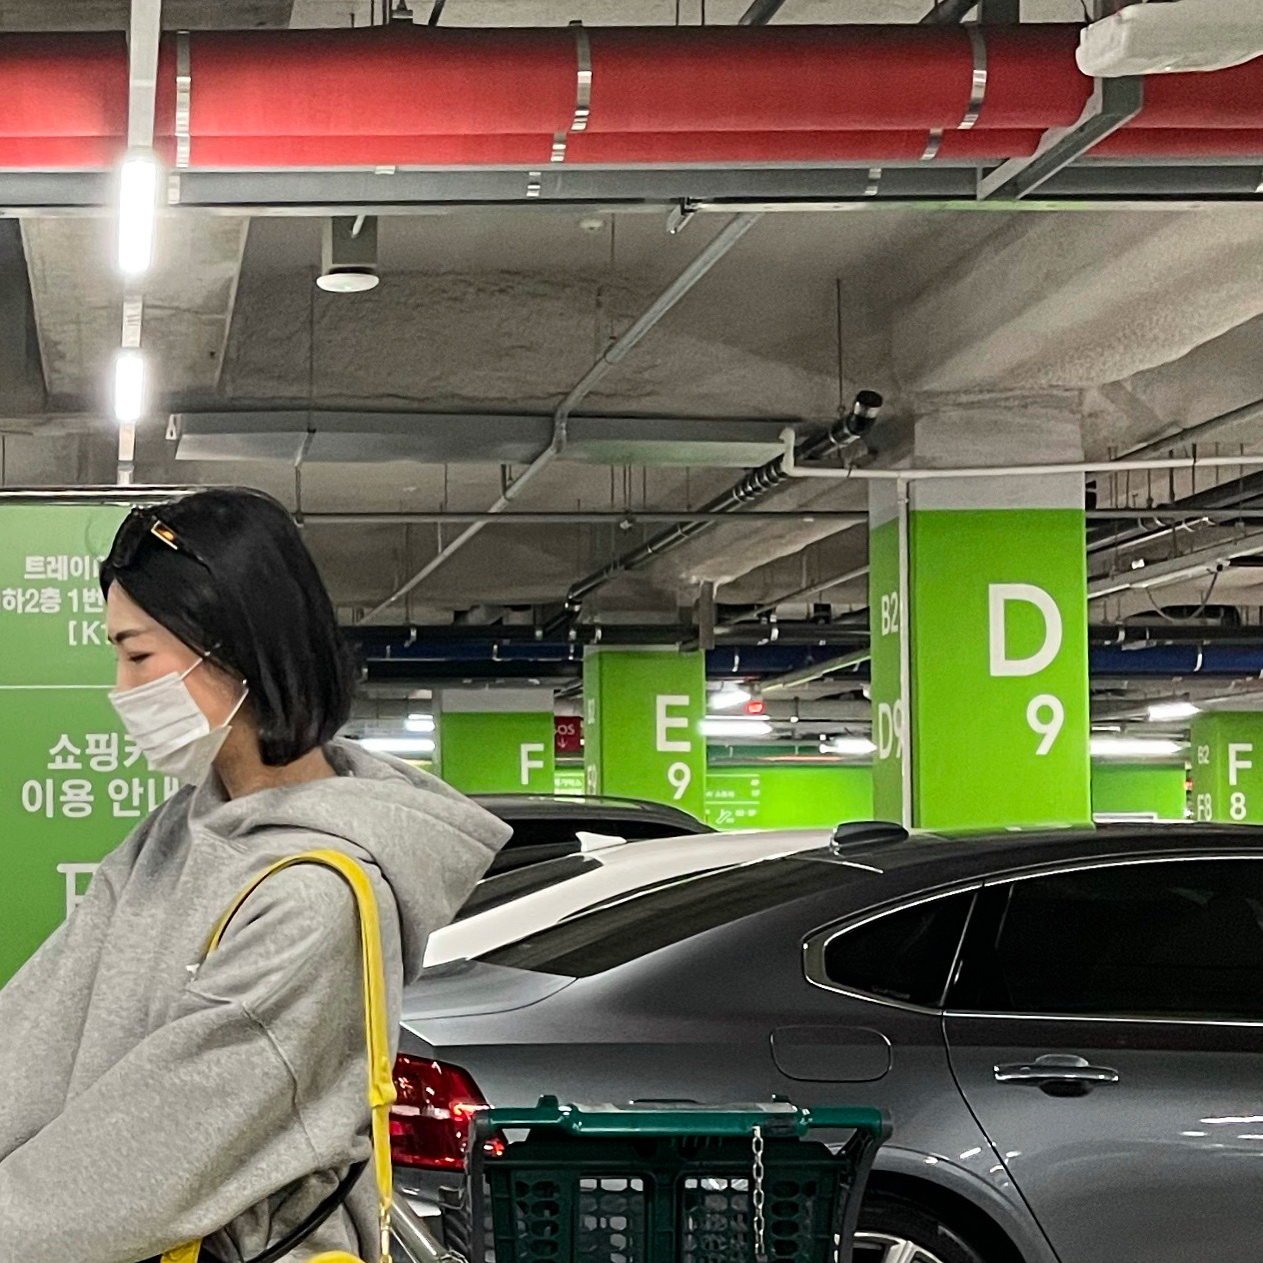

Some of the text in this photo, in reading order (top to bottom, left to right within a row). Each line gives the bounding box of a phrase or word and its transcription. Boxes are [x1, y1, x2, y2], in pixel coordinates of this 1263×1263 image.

[23, 555, 100, 580] 트레이
[881, 591, 899, 636] B2
[988, 582, 1063, 677] D
[554, 723, 575, 736] OS
[655, 694, 692, 753] E
[1026, 693, 1065, 756] 9
[520, 743, 545, 786] F
[667, 761, 692, 800] 9
[1228, 743, 1253, 786] F
[21, 778, 95, 819] 이용
[1229, 791, 1247, 821] 8
